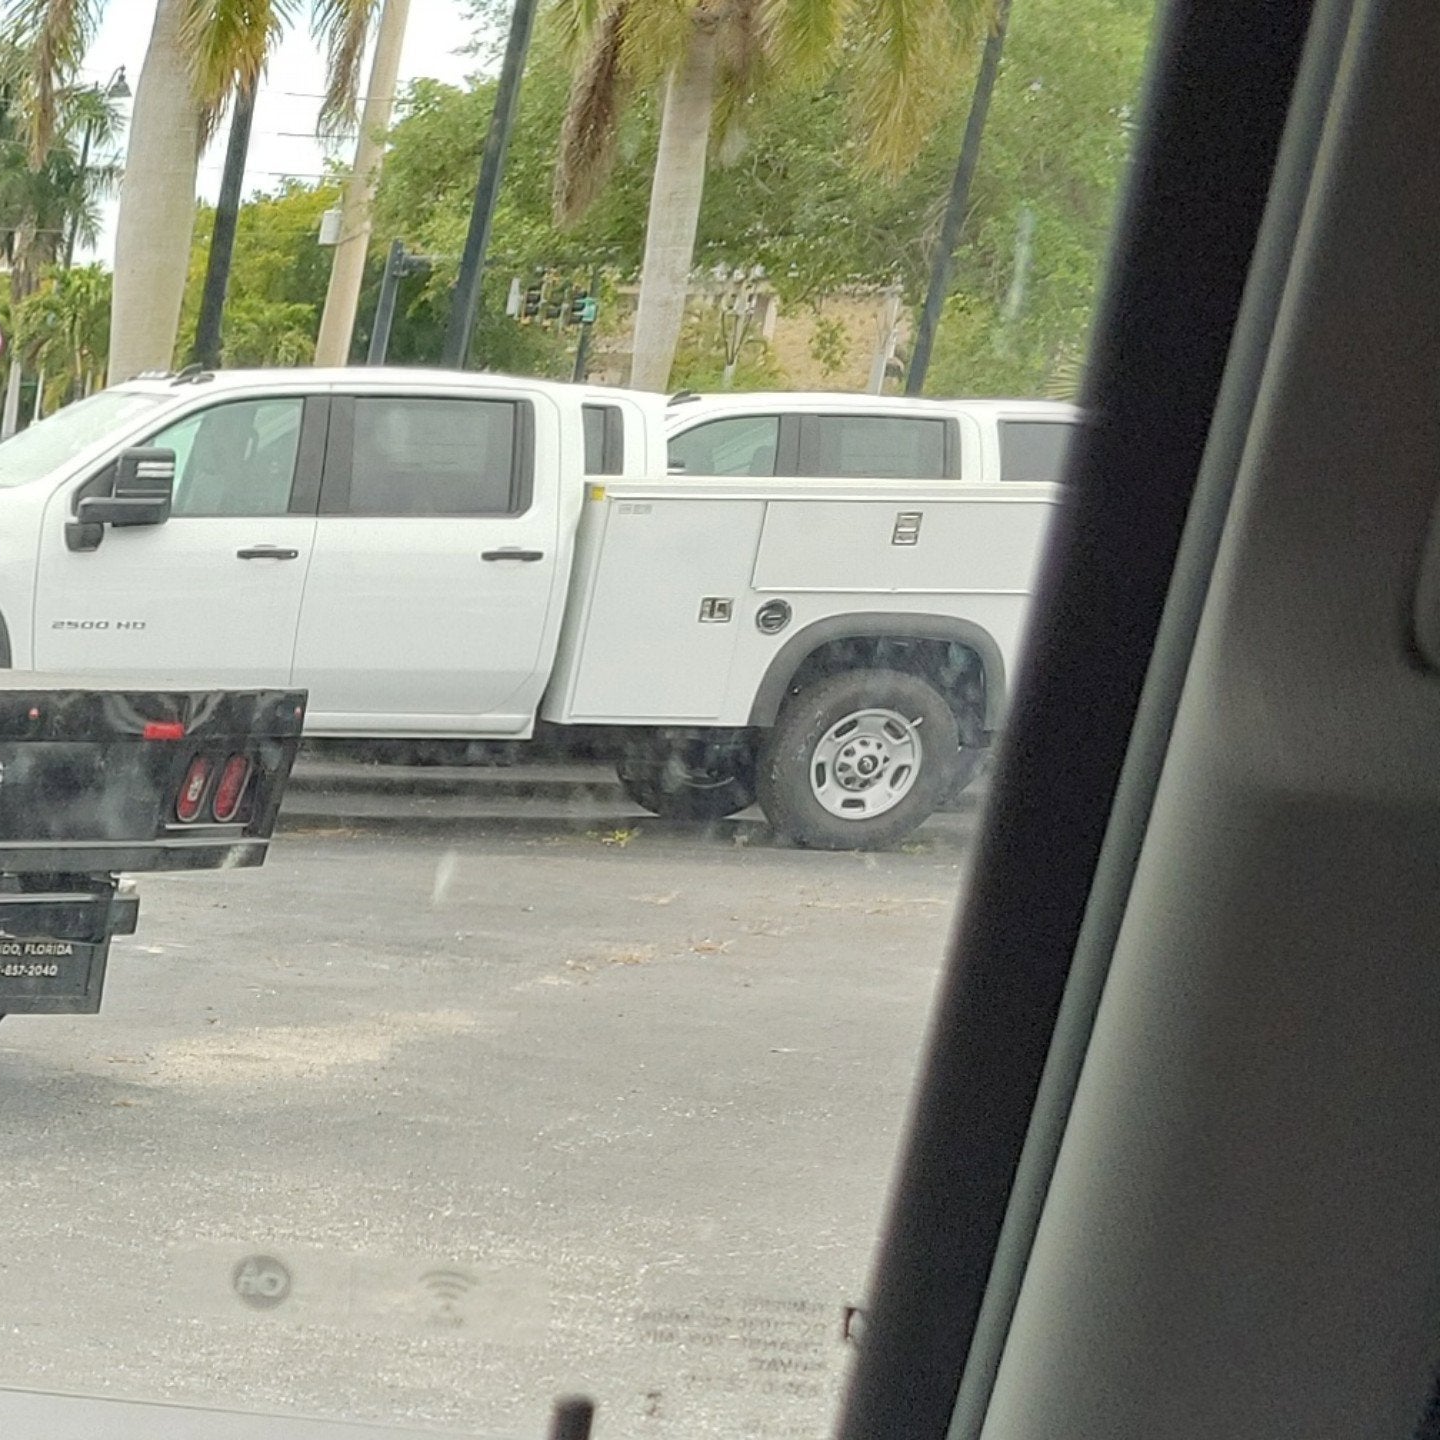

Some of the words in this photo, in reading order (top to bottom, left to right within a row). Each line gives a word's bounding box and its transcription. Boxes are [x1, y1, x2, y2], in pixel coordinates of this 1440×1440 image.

[52, 621, 109, 630] 2500
[116, 621, 146, 630] HD
[25, 943, 73, 955] FLORIDA
